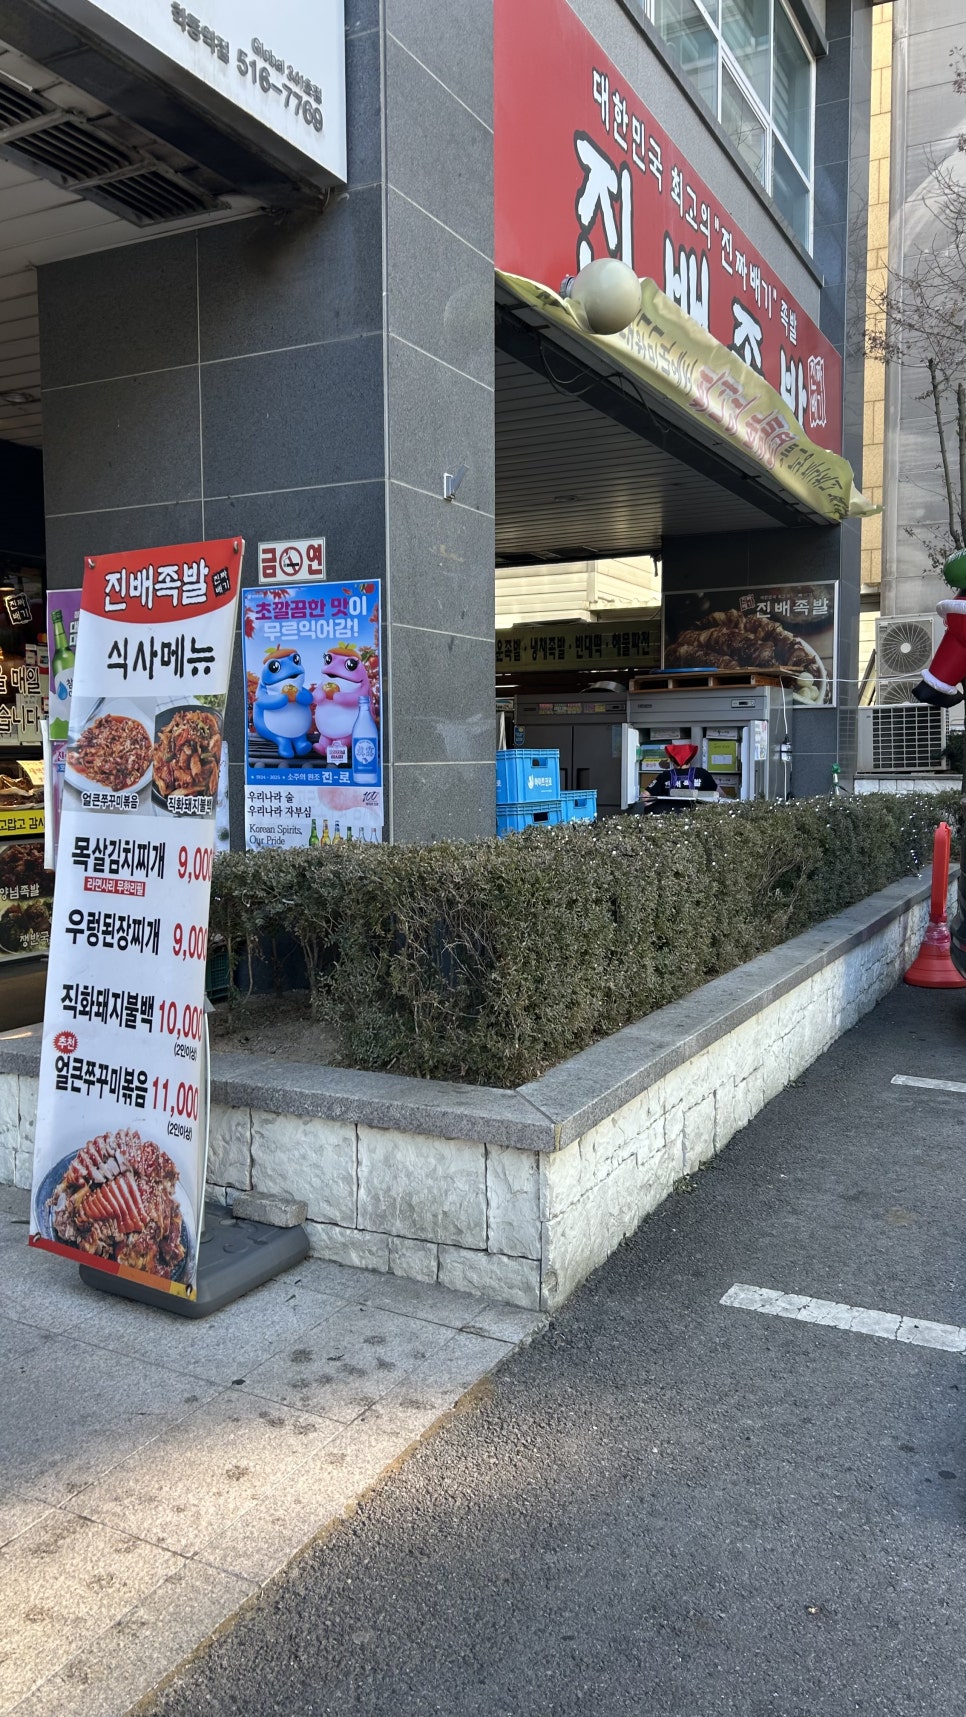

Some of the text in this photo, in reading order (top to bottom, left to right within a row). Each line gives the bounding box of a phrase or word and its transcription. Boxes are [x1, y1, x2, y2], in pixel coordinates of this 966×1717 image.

[251, 37, 285, 75] Global
[237, 48, 323, 132] 516-7769
[592, 66, 664, 192] 대한민국
[670, 163, 711, 249] 최고의
[780, 299, 797, 345] 족발
[104, 557, 210, 613] 진배족발
[255, 596, 367, 620] 초깔끔한 맛이
[757, 598, 829, 618] 진배족발
[264, 618, 359, 641] 무르익어감!
[107, 633, 216, 680] 식사메뉴
[530, 636, 566, 661] 냉채족발
[575, 634, 603, 660] 빈대떡
[611, 631, 650, 657] 해물파전
[11, 665, 41, 695] 매일
[247, 791, 294, 804] 우리나라 술
[247, 805, 311, 818] 우리나라 자부심
[249, 824, 275, 833] Korean
[267, 836, 285, 845] Pride
[72, 837, 165, 879] 목살김치찌개
[0, 883, 40, 900] 양념족발
[87, 878, 144, 895] 라면사리 무한리필
[20, 931, 49, 947] 쟁반국
[65, 909, 161, 955] 우렁된장찌개
[61, 983, 203, 1042] 직화돼지불백 10,000
[58, 1036, 75, 1050] 추천
[55, 1055, 199, 1121] 얼큰쭈꾸미볶음 11,000
